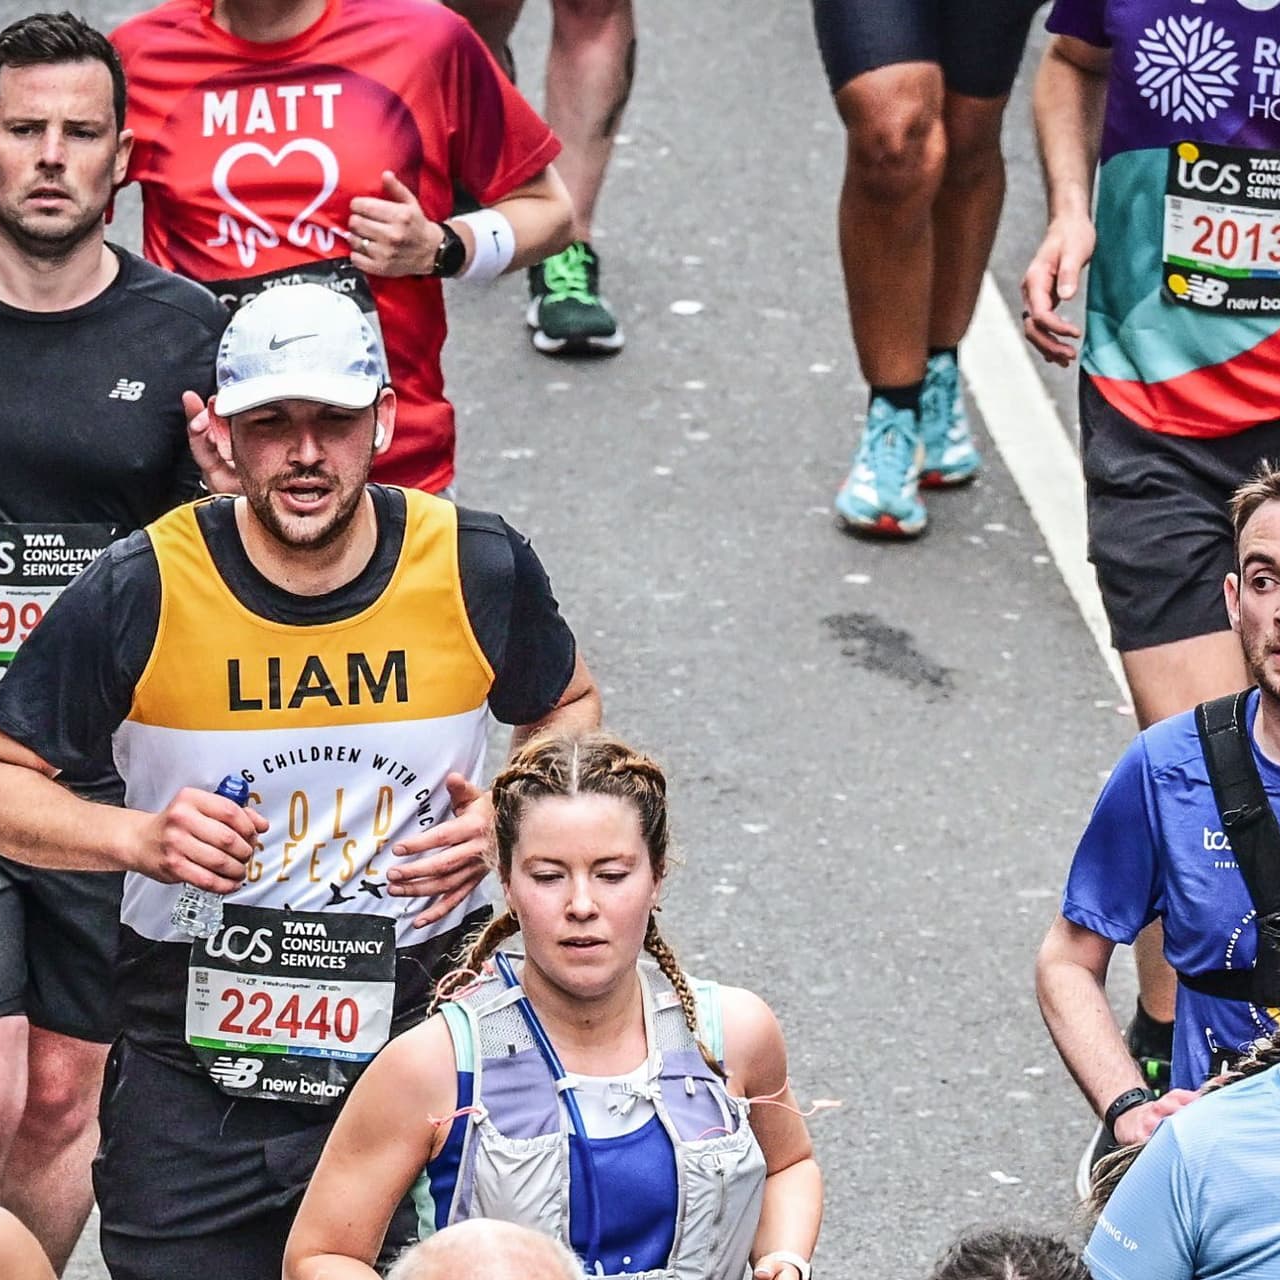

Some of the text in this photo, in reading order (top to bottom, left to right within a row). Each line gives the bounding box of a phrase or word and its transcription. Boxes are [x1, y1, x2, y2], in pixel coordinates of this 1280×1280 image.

[202, 83, 342, 137] MATT
[1177, 155, 1242, 195] tcs
[1226, 297, 1259, 310] new
[22, 533, 66, 547] TATA
[22, 547, 107, 562] CONSULTAN
[22, 562, 84, 577] SERVICES
[227, 649, 409, 711] LIAM
[262, 746, 417, 785] CHILDREN WITH
[282, 921, 327, 937] TATA
[205, 923, 273, 964] tcs
[281, 937, 384, 955] CONSULTANCY
[280, 953, 346, 969] SERVICES
[217, 988, 360, 1043] 22440
[262, 1078, 345, 1097] new balan
